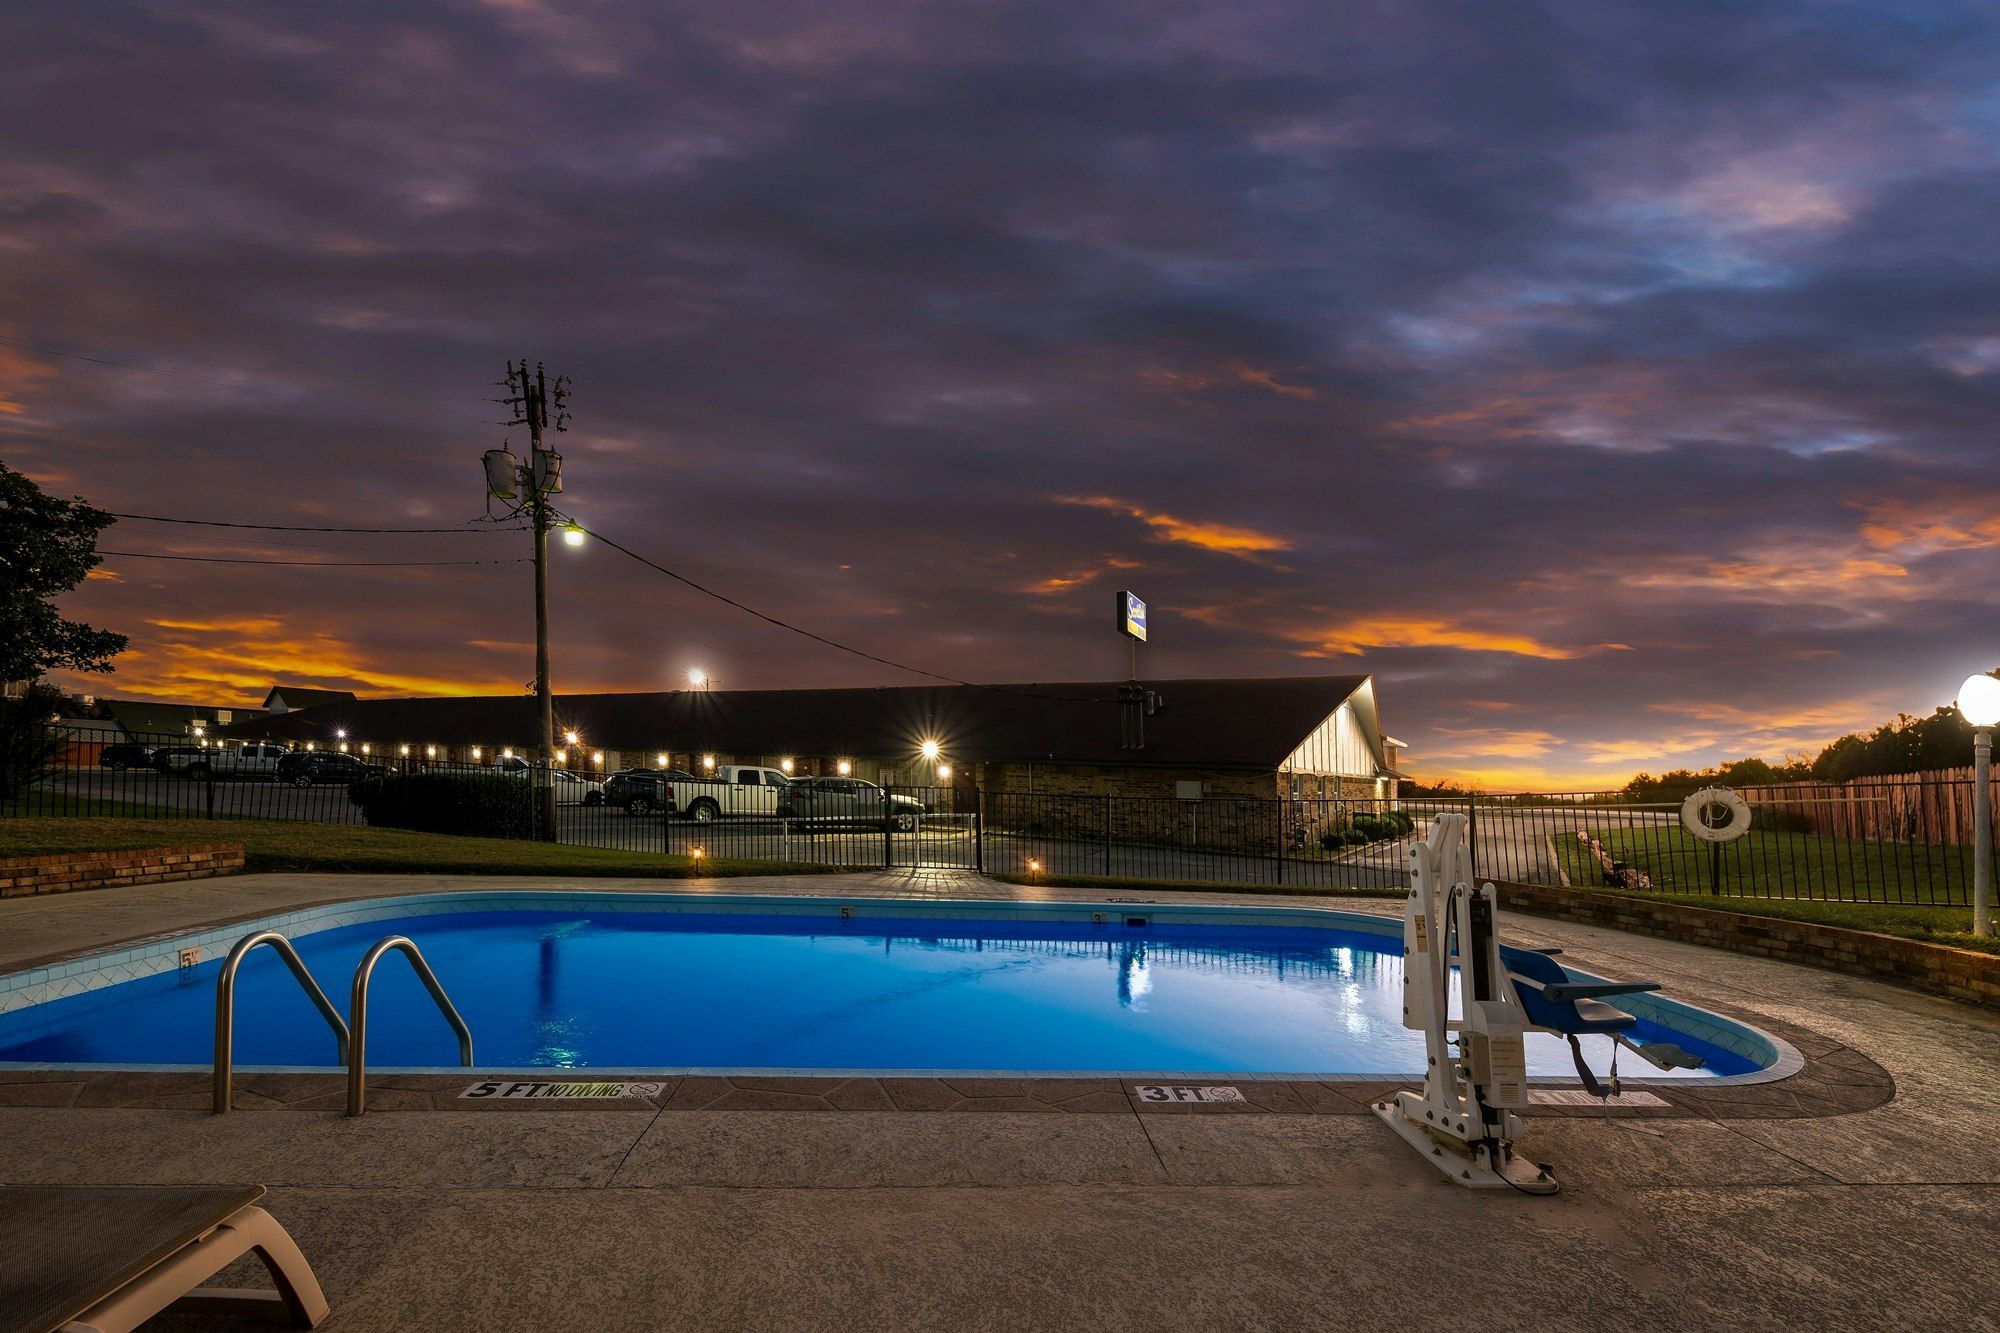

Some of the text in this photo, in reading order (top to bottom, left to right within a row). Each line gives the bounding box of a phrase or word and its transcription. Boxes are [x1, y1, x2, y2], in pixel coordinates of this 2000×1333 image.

[466, 1082, 503, 1097] 5
[541, 1083, 570, 1097] NO
[564, 1083, 625, 1097] DIVING
[1142, 1086, 1170, 1101] 3
